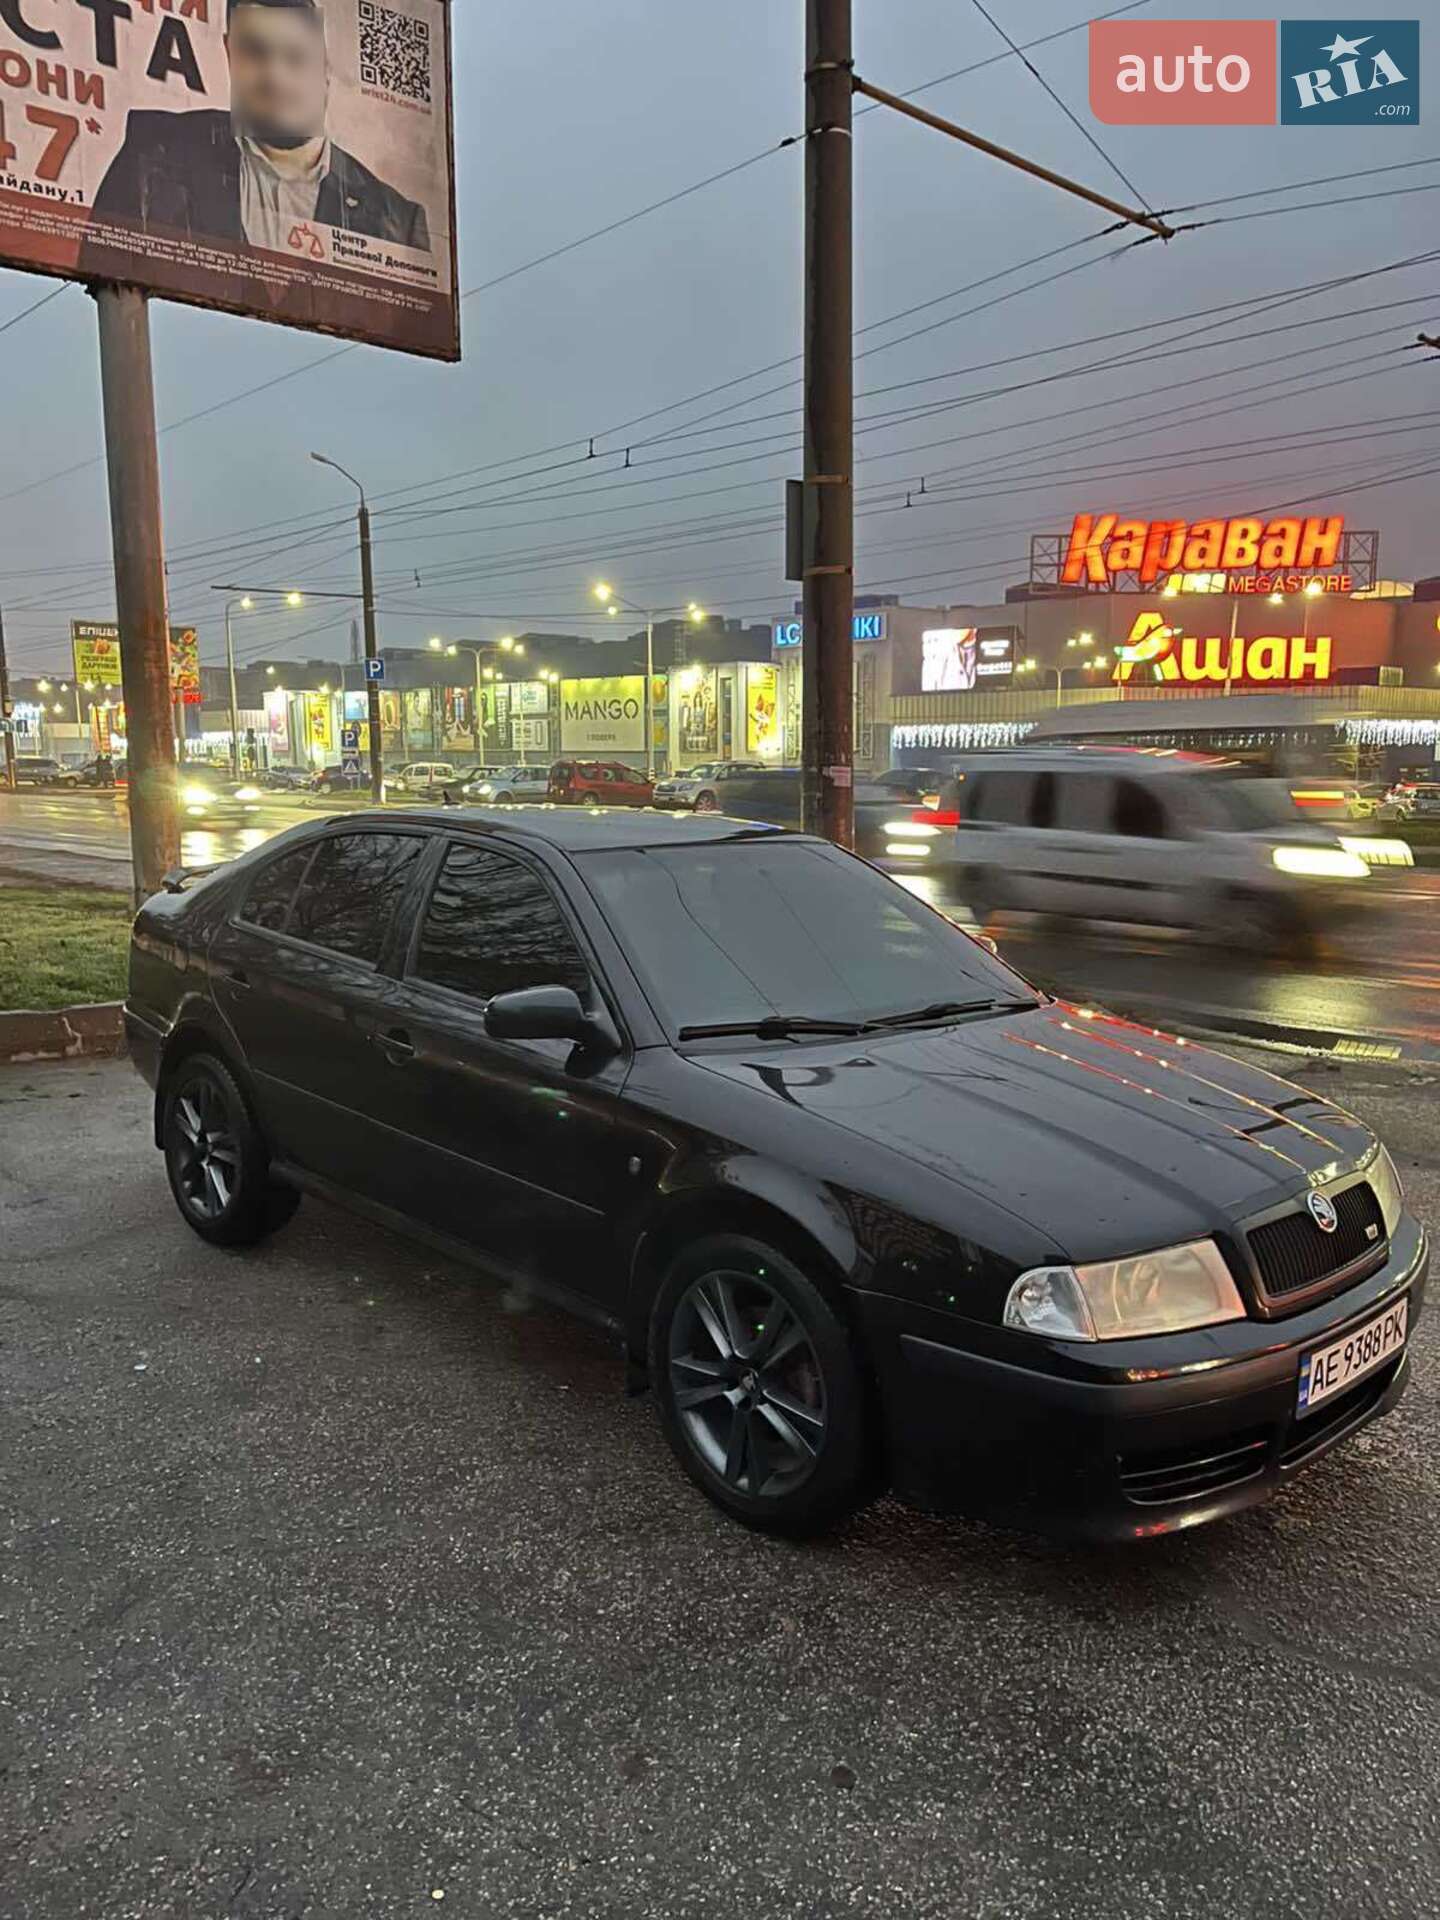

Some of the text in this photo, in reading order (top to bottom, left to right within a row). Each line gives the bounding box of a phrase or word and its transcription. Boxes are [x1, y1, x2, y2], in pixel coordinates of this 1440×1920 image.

[332, 229, 367, 248] Центр
[333, 242, 382, 263] Правової
[384, 256, 437, 277] Допомоги
[1061, 514, 1345, 584] Караван
[1228, 575, 1352, 593] MEGASTORE
[775, 622, 801, 646] LC
[1112, 612, 1332, 682] Ашан
[369, 660, 381, 677] P
[564, 698, 639, 720] MANGO
[344, 731, 354, 746] P
[1311, 1305, 1405, 1397] AE 9388 PK
